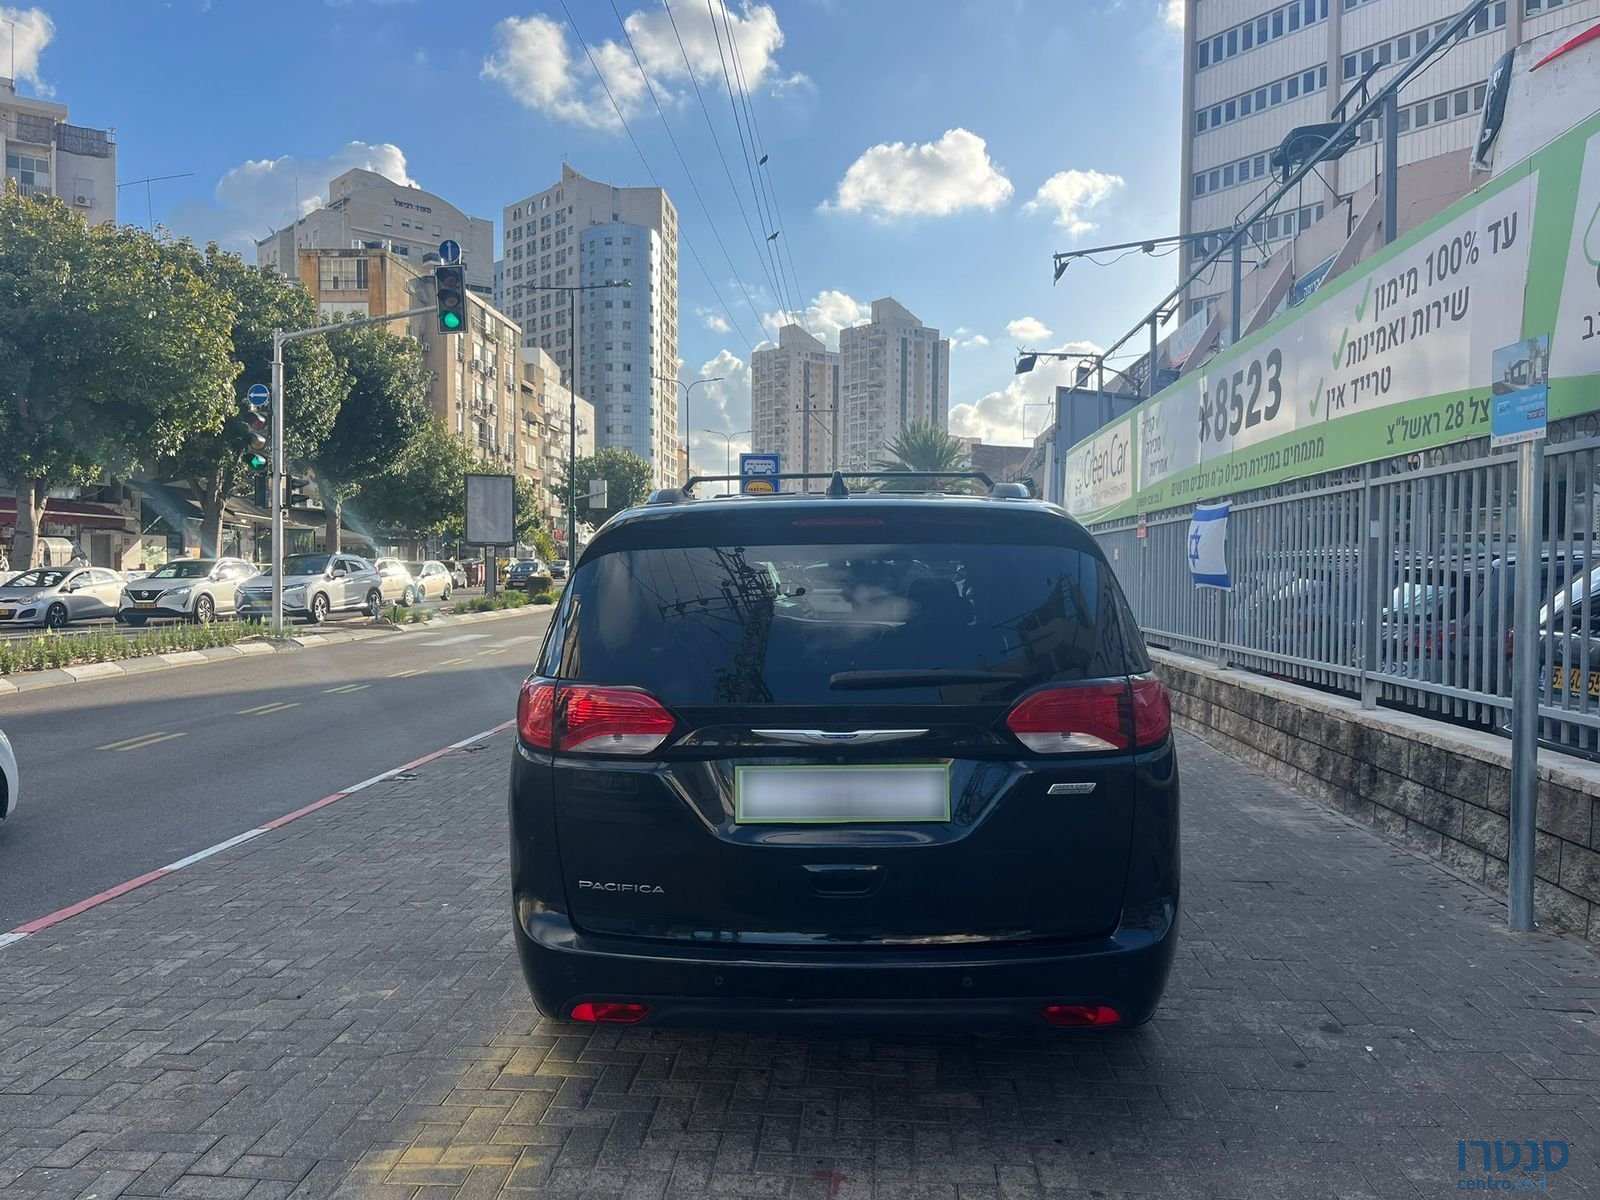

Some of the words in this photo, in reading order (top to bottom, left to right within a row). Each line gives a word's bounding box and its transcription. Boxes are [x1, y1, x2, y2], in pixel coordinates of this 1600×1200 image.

[1487, 211, 1518, 254] עד
[1425, 230, 1479, 287] 100%
[1374, 267, 1418, 322] מימון
[1410, 286, 1470, 340] שירות
[1345, 316, 1406, 368] ואמינות
[1326, 382, 1346, 421] אין
[1351, 365, 1392, 404] טרייד
[1445, 400, 1464, 431] 28
[1110, 433, 1128, 477] Car
[1250, 451, 1281, 478] במכירת
[1282, 436, 1325, 467] מתמחים
[1171, 477, 1190, 496] חדשים
[578, 880, 665, 893] PACIFICA
